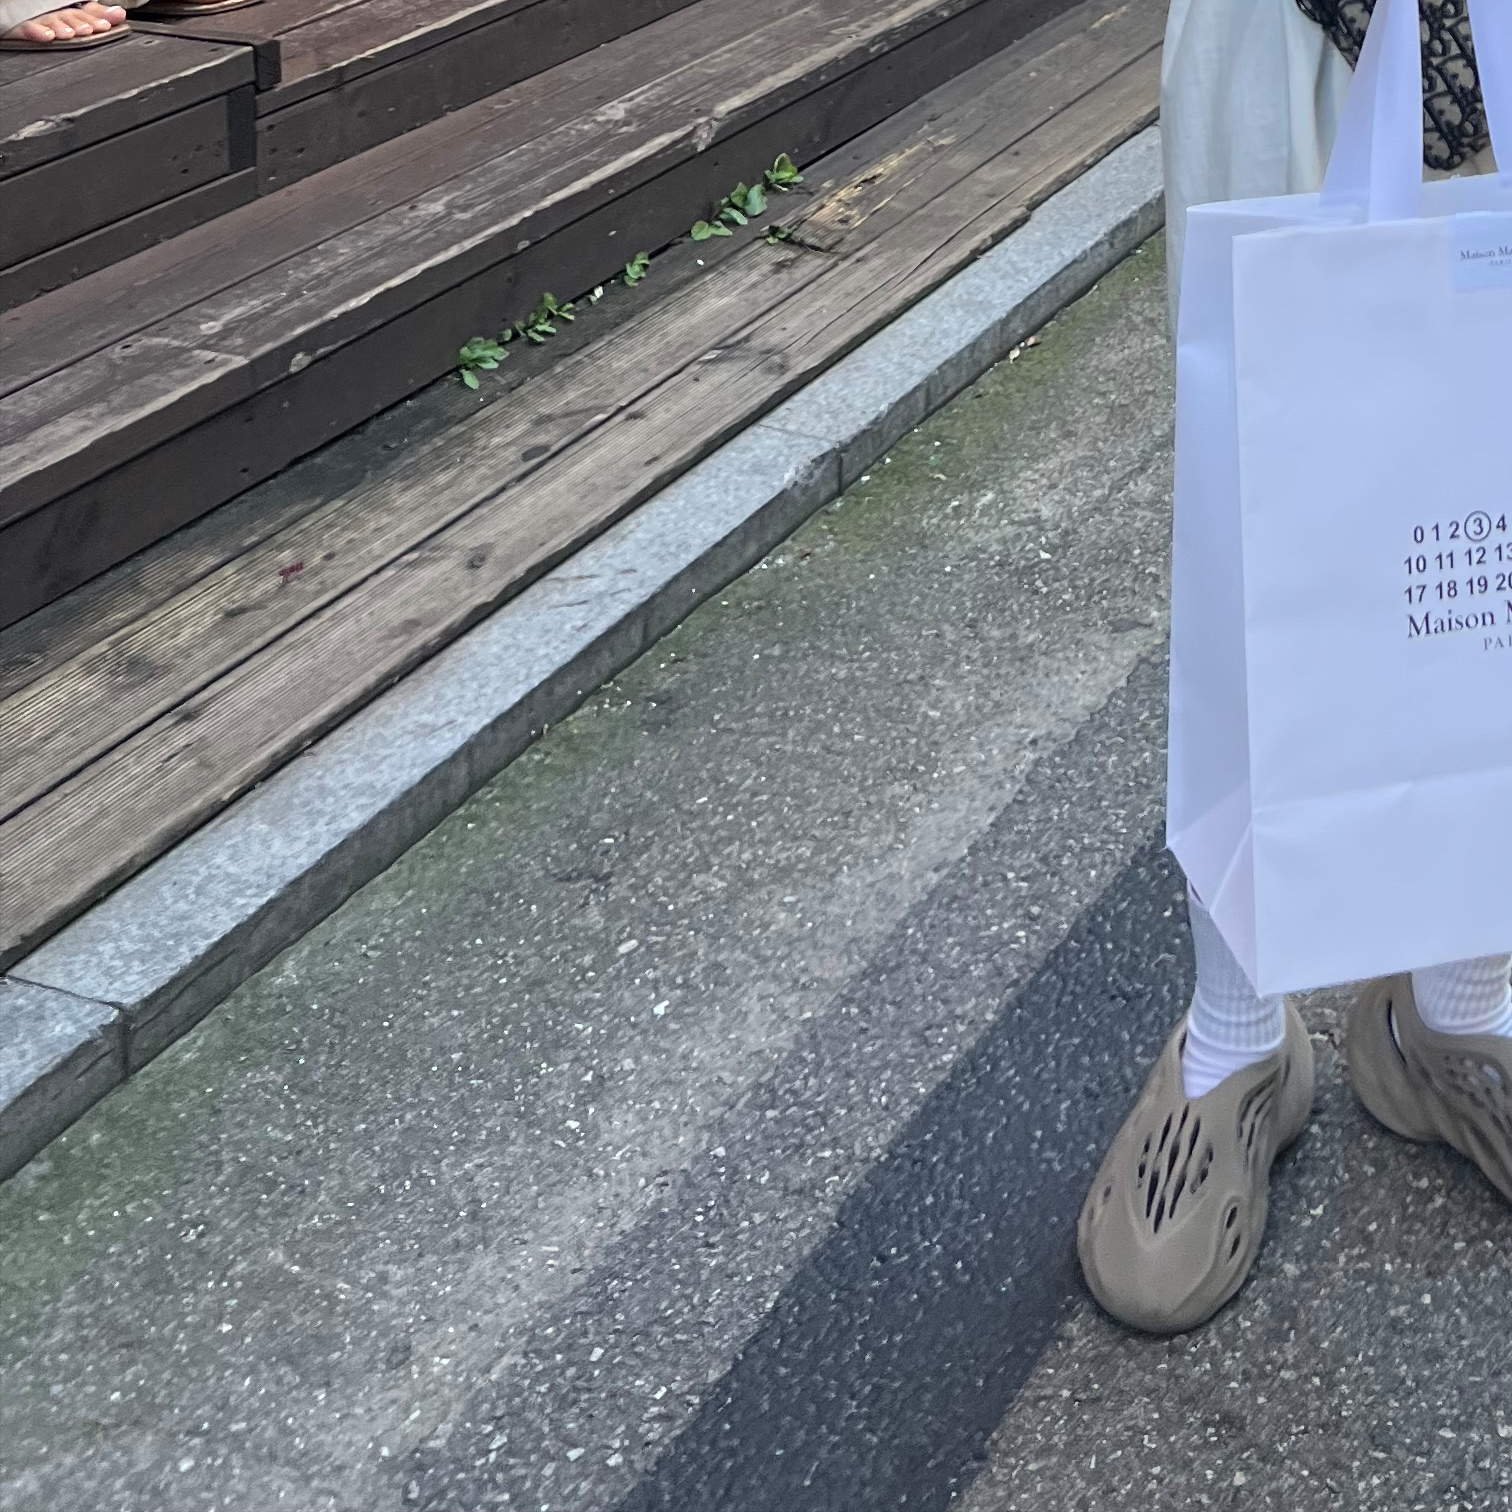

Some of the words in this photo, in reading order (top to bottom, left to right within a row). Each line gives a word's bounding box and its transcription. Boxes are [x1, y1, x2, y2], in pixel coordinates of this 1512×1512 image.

[1460, 248, 1496, 260] Maison
[1413, 525, 1425, 544] 0
[1431, 522, 1440, 541] 1
[1449, 520, 1460, 539] 2
[1495, 513, 1507, 532] 4
[1404, 554, 1427, 575] 10
[1435, 549, 1455, 570] 11
[1464, 546, 1487, 566] 12
[1404, 584, 1427, 605] 17
[1435, 579, 1458, 600] 18
[1465, 575, 1488, 596] 19
[1407, 609, 1496, 638] Maison
